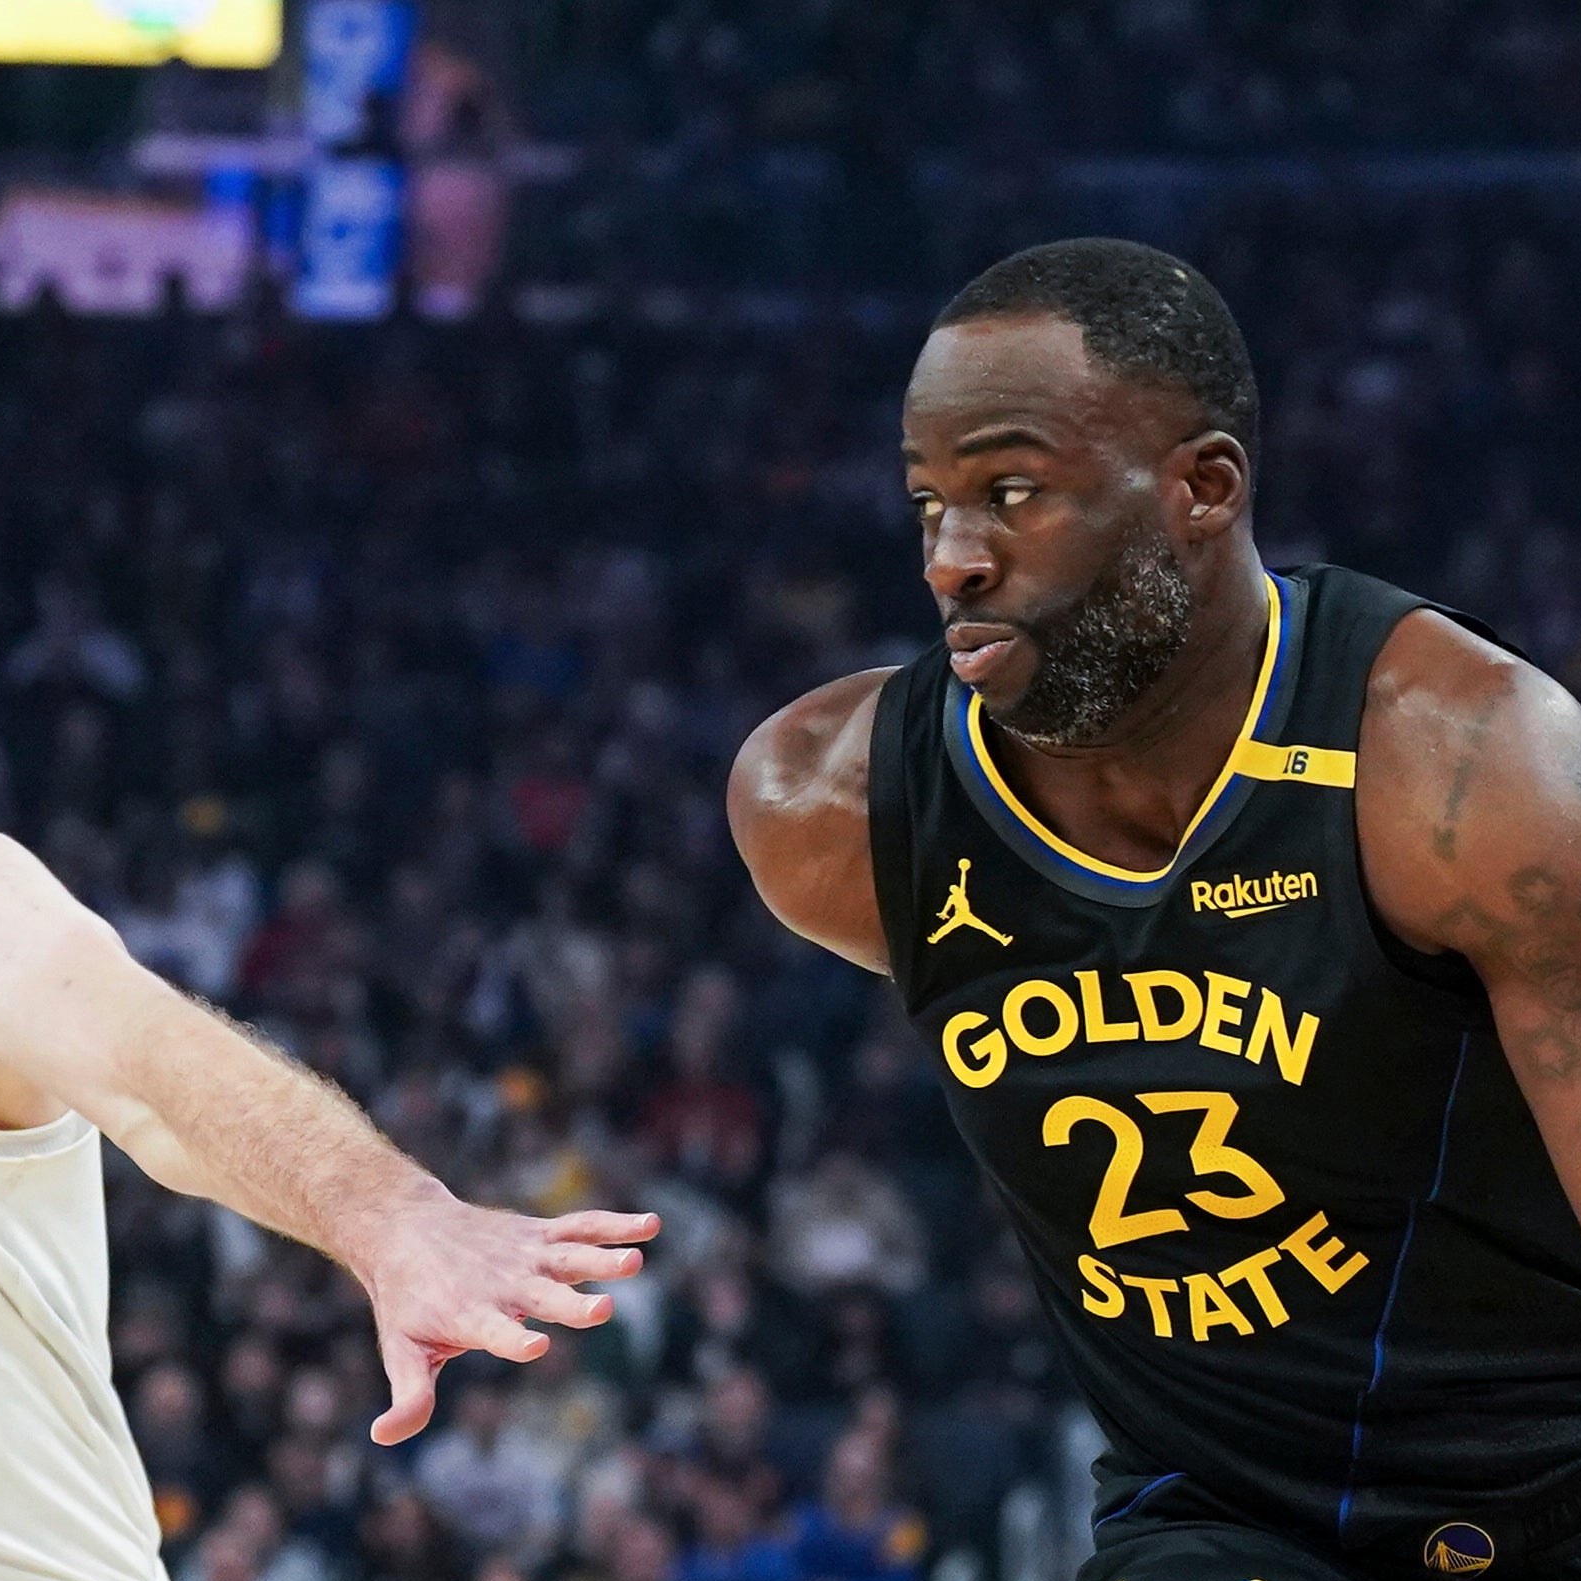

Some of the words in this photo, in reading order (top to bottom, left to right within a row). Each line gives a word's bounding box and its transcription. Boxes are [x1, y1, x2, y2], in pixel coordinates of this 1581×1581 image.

[1191, 870, 1318, 914] Rakuten
[942, 970, 1320, 1087] GOLDEN
[1042, 1091, 1285, 1250] 23
[1077, 1210, 1370, 1342] STATE
